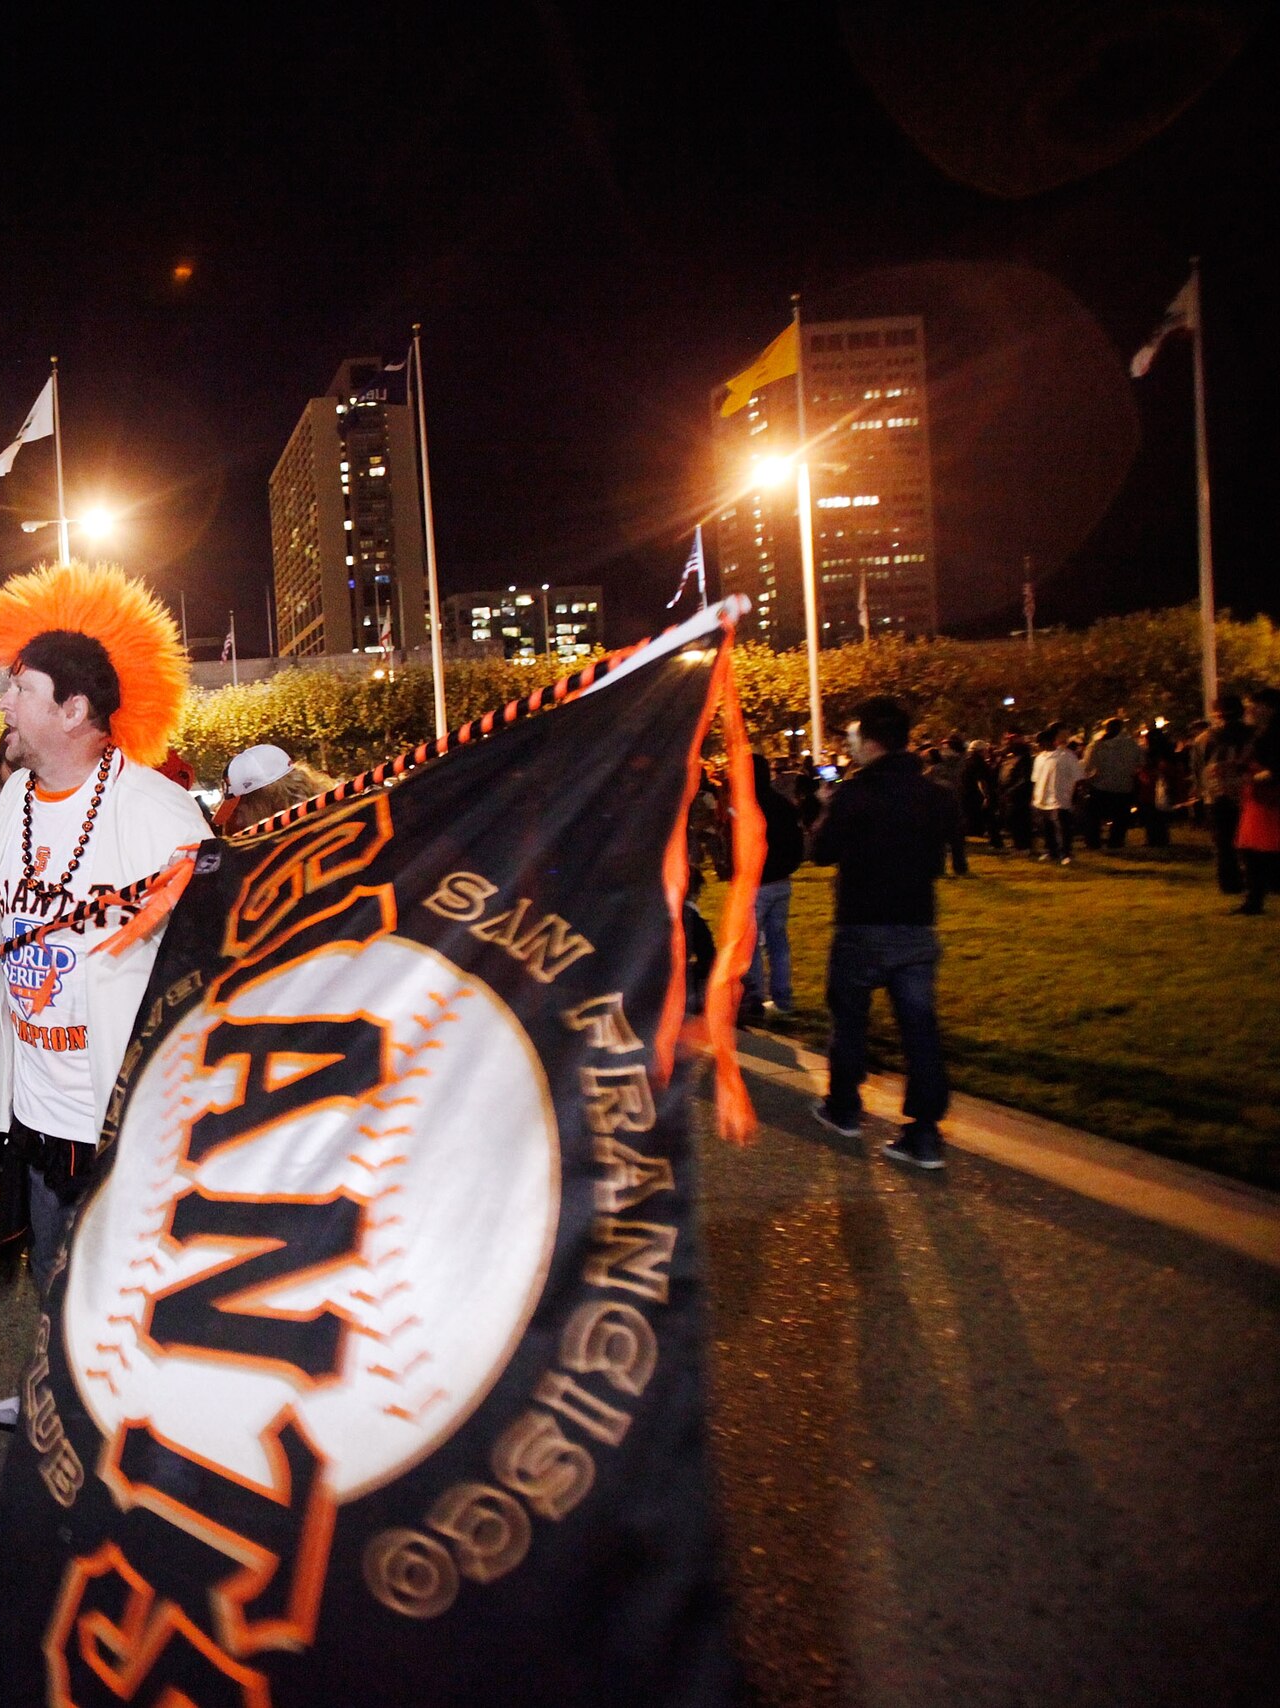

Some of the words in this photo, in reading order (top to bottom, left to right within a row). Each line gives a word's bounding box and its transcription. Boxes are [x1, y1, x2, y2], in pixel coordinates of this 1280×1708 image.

[7, 945, 75, 973] ORLD
[423, 871, 596, 986] SAN
[363, 991, 677, 1618] FRANCISCO
